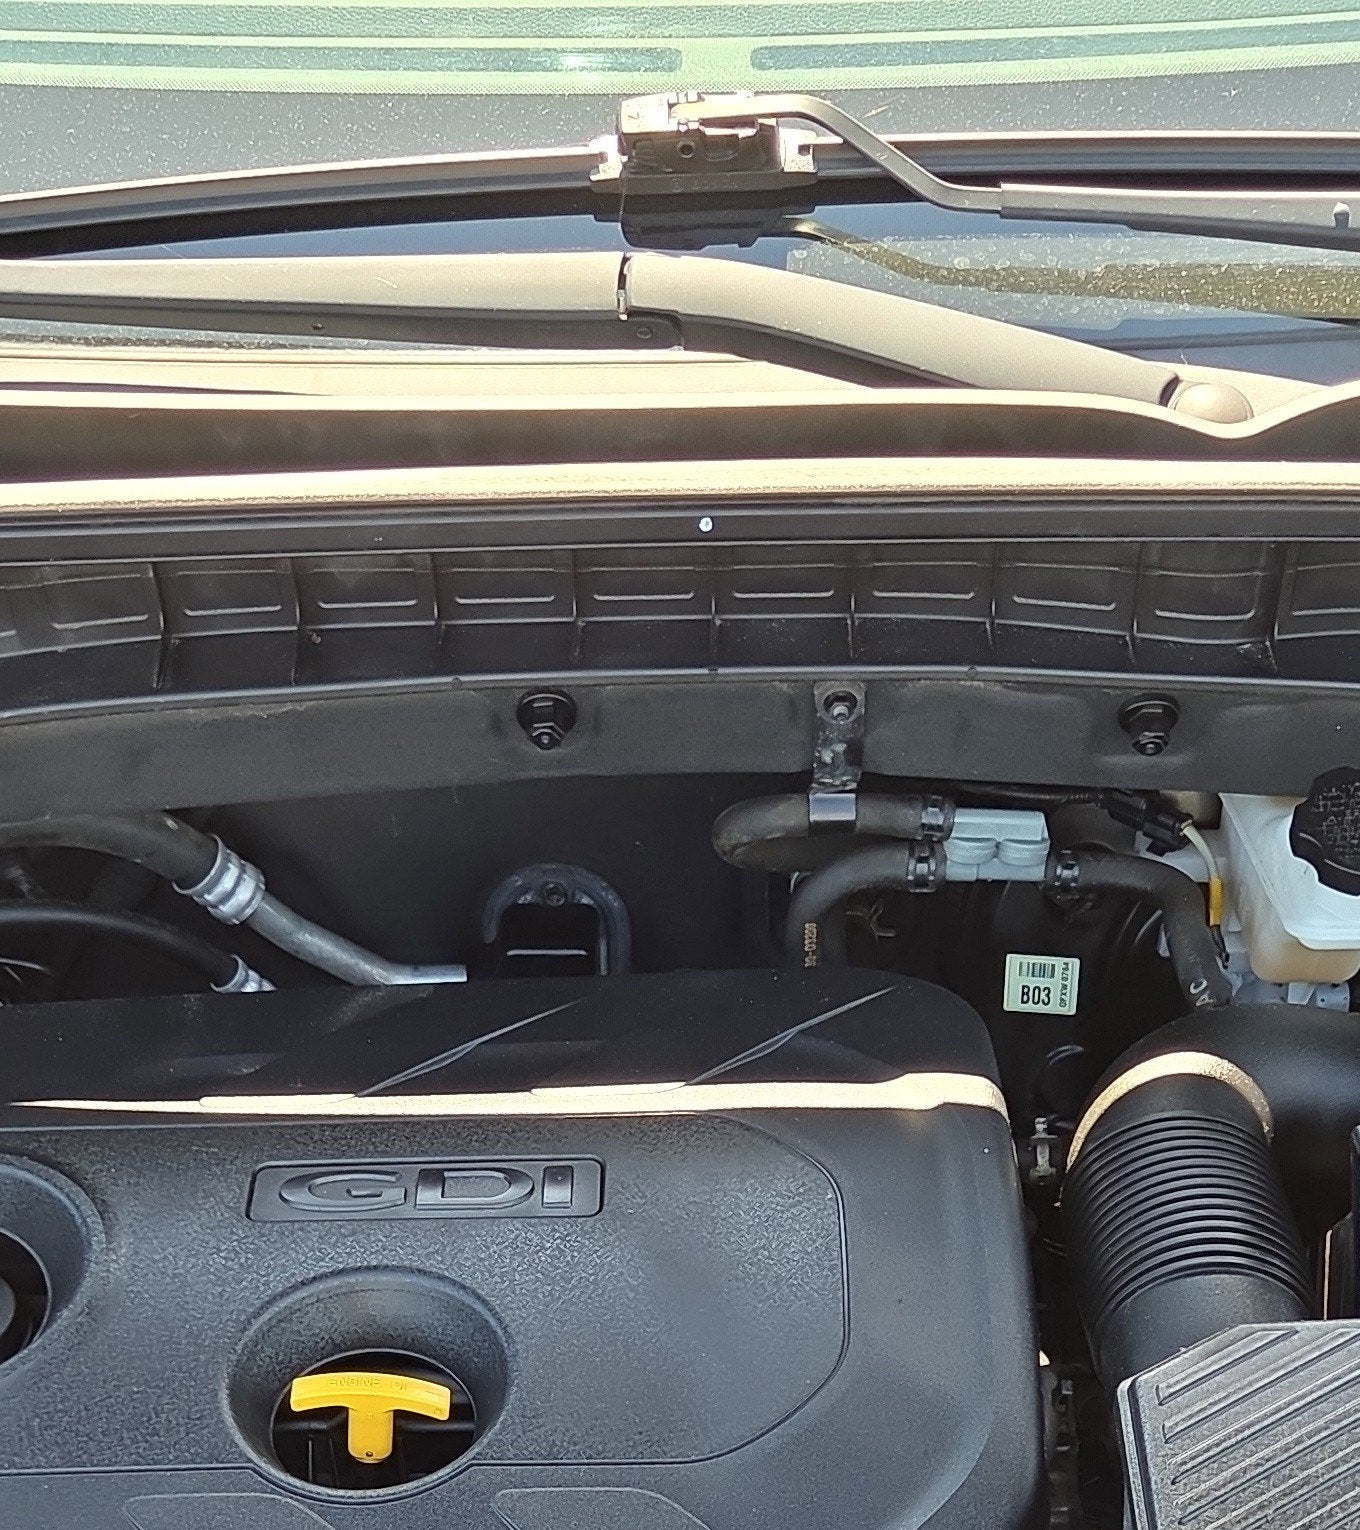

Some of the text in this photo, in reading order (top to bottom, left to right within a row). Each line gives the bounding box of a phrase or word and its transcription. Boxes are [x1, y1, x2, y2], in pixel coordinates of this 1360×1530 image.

[1020, 985, 1052, 1006] B03
[279, 1165, 574, 1212] GDI
[328, 1377, 381, 1388] ENGINE
